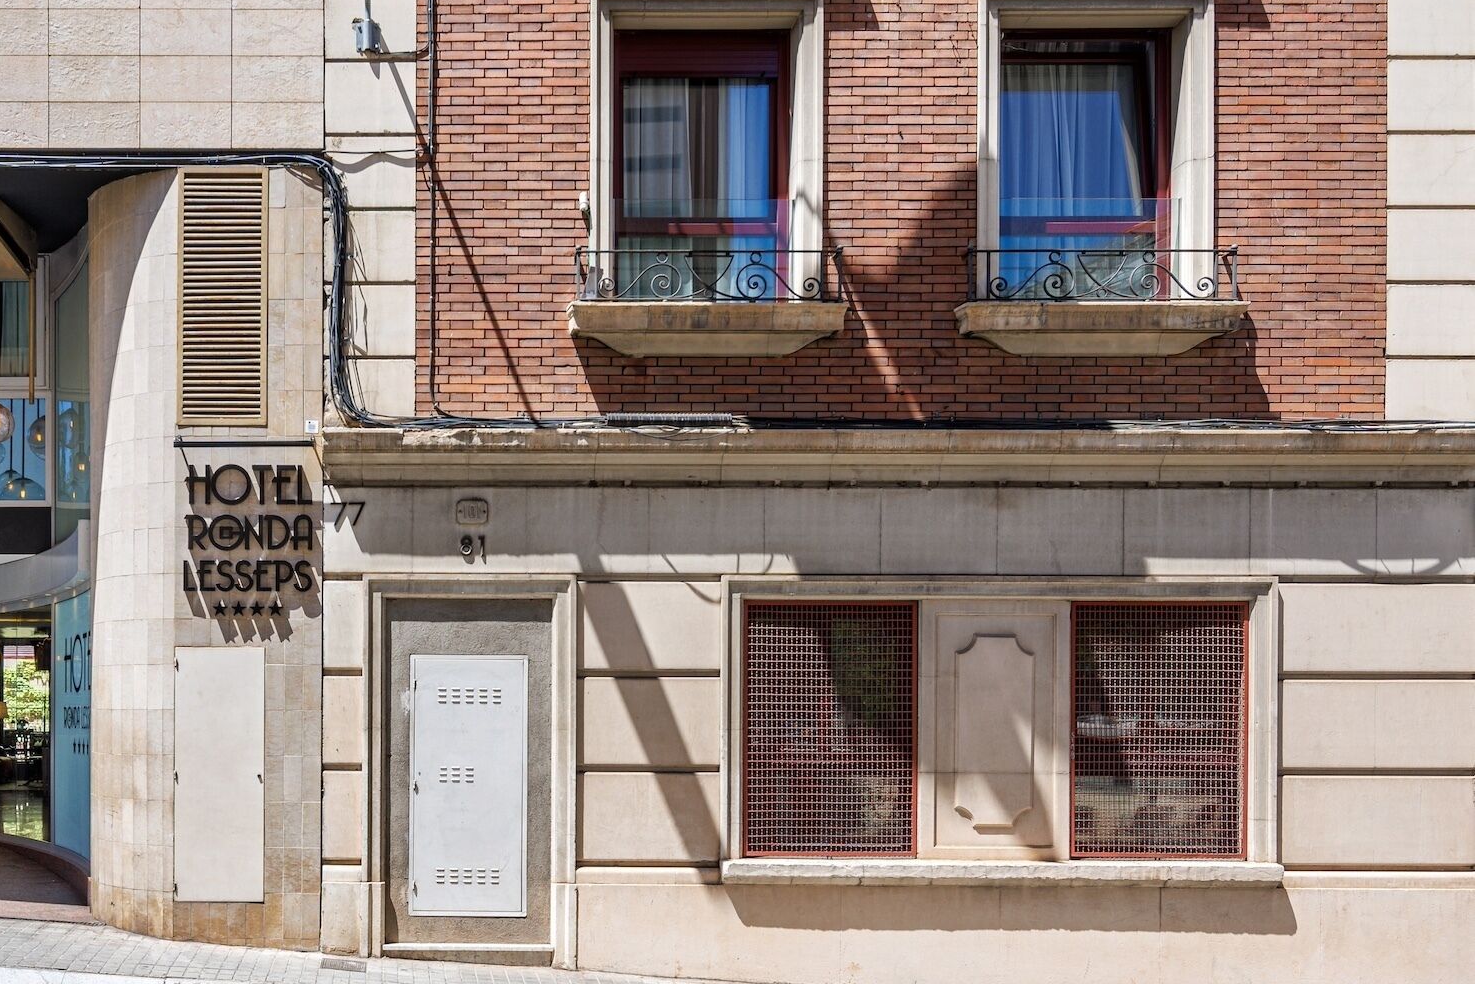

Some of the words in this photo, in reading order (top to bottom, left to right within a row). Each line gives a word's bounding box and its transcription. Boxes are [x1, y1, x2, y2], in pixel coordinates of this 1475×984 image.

[184, 464, 313, 505] HOTEL
[330, 501, 366, 526] 77
[184, 514, 313, 551] RONDA
[460, 535, 485, 557] 81
[183, 560, 313, 592] LESSEPS
[64, 630, 91, 693] HOTE
